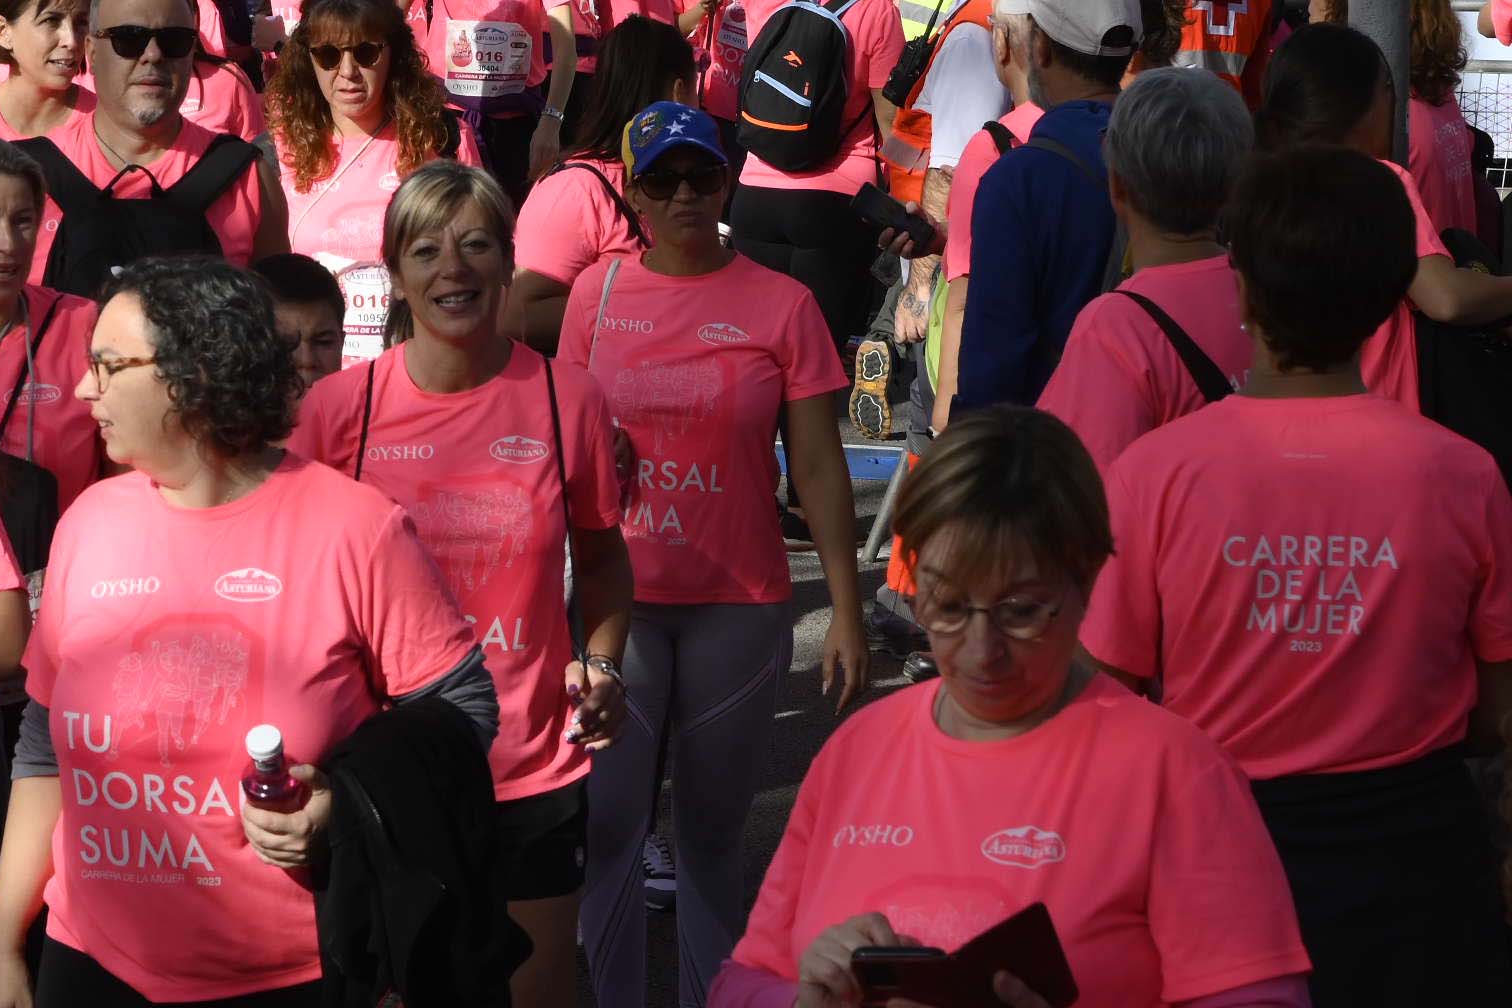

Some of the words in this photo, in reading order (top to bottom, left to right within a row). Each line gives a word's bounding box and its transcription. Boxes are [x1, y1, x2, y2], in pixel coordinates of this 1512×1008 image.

[476, 51, 503, 62] 016
[353, 294, 389, 308] 016
[367, 444, 434, 461] OYSHO
[494, 444, 545, 457] ASTURIANA
[638, 459, 723, 493] RSAL
[1223, 535, 1399, 570] CARRERA
[91, 575, 161, 600] OYSHO
[219, 580, 276, 594] ASTURIANA
[1256, 569, 1305, 601] DE
[1317, 571, 1364, 602] LA
[1245, 602, 1366, 637] MUJER
[1290, 639, 1323, 653] 2023
[63, 710, 112, 753] TU
[72, 768, 235, 817] DORSA
[78, 824, 215, 872] SUMA
[80, 868, 121, 882] CARRERA
[123, 871, 135, 883] DE
[137, 872, 150, 883] LA
[152, 872, 185, 884] MUJER
[197, 875, 223, 886] 2023
